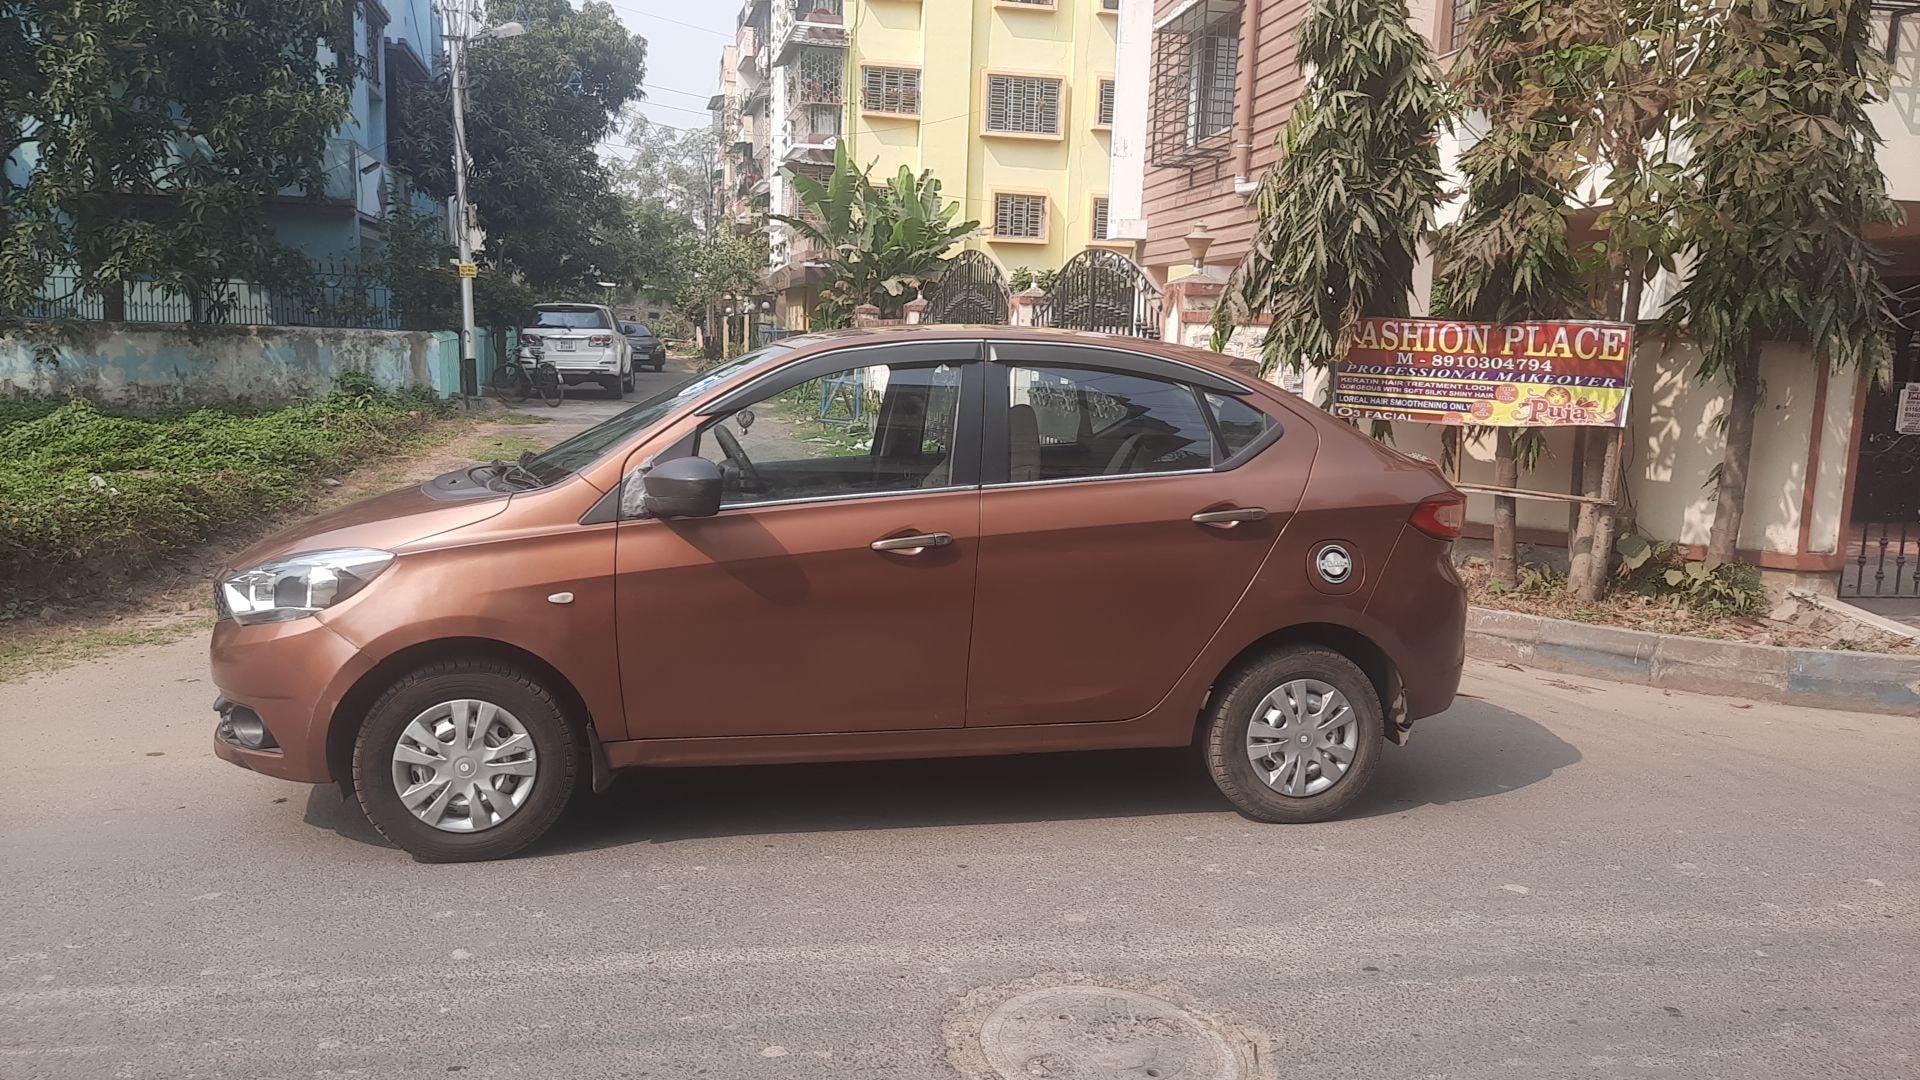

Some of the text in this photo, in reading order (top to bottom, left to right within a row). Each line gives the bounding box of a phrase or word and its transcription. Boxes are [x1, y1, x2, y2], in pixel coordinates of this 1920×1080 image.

[1500, 325, 1627, 361] PLACE
[1396, 352, 1414, 365] M
[1431, 354, 1553, 372] 8910304794
[1340, 377, 1494, 392] KERATIN HAIR TREATMENT LOOK
[1346, 363, 1617, 388] PROFESSIONAL MAKEOVER
[1340, 383, 1381, 392] GORGEOUS
[1403, 387, 1423, 395] SOFT
[1425, 389, 1448, 397] SILKY
[1449, 390, 1473, 398] SHINY
[1339, 395, 1369, 404] LOREAL
[1369, 397, 1389, 406] HAIR
[1390, 398, 1448, 410] SMOOTHENING
[1449, 402, 1472, 411] ONLY
[1528, 399, 1587, 422] Puja
[1365, 410, 1413, 421] FACIAL
